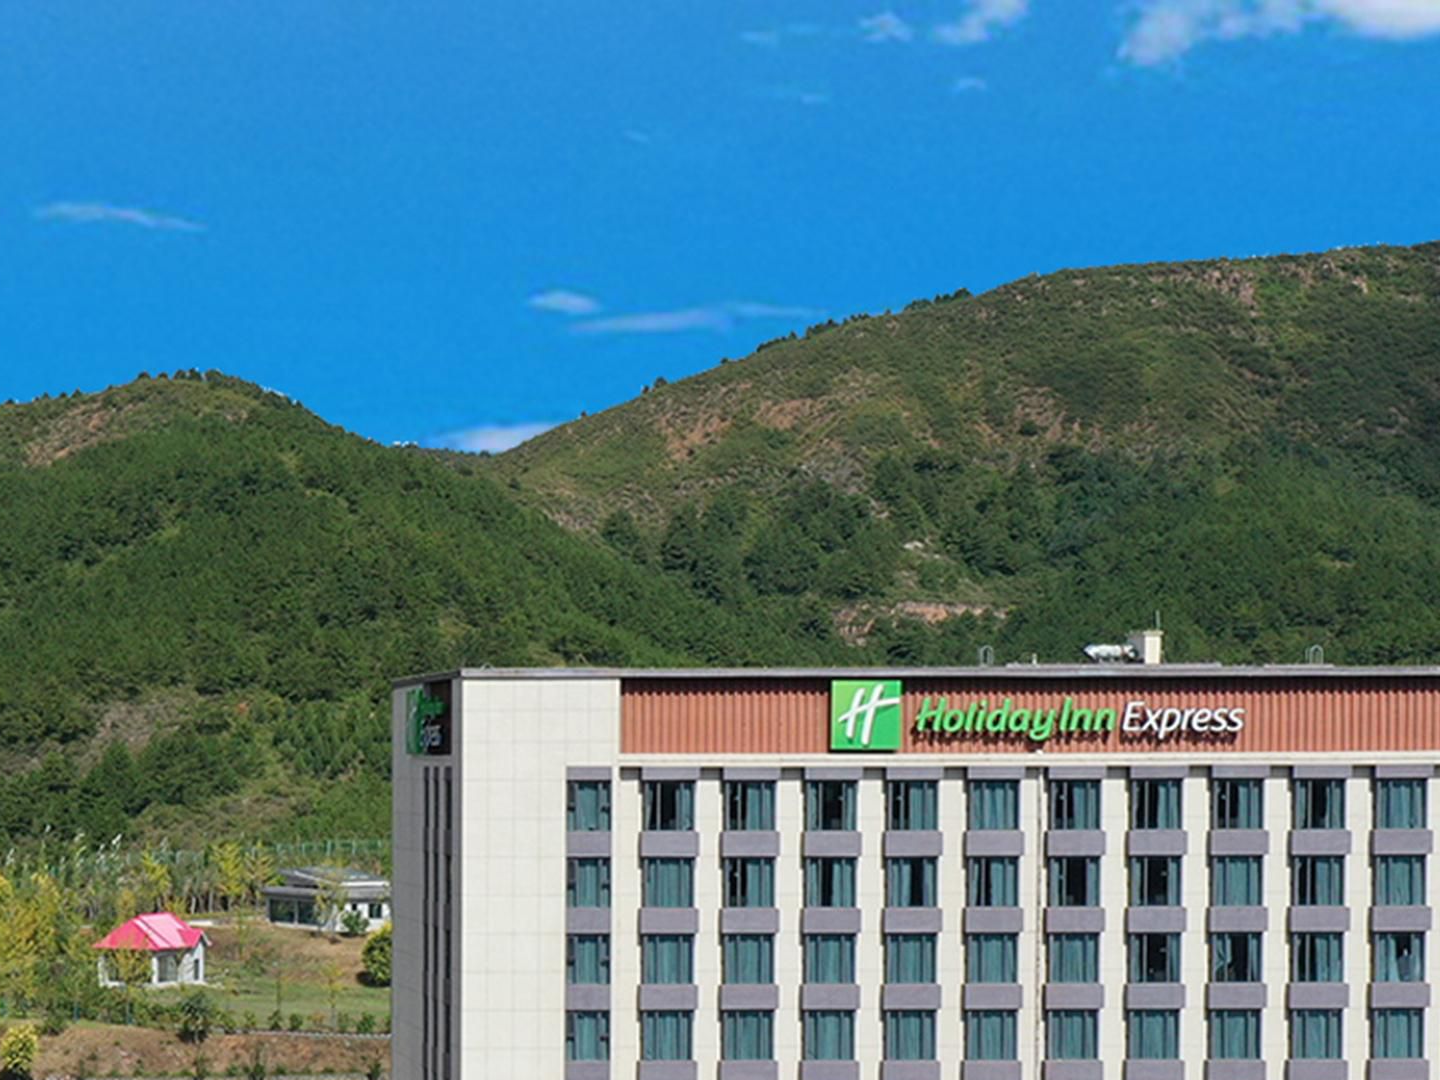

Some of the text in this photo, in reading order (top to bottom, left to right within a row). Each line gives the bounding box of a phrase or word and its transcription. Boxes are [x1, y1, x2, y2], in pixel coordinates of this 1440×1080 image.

[915, 697, 1246, 741] Holiday Inn Express
